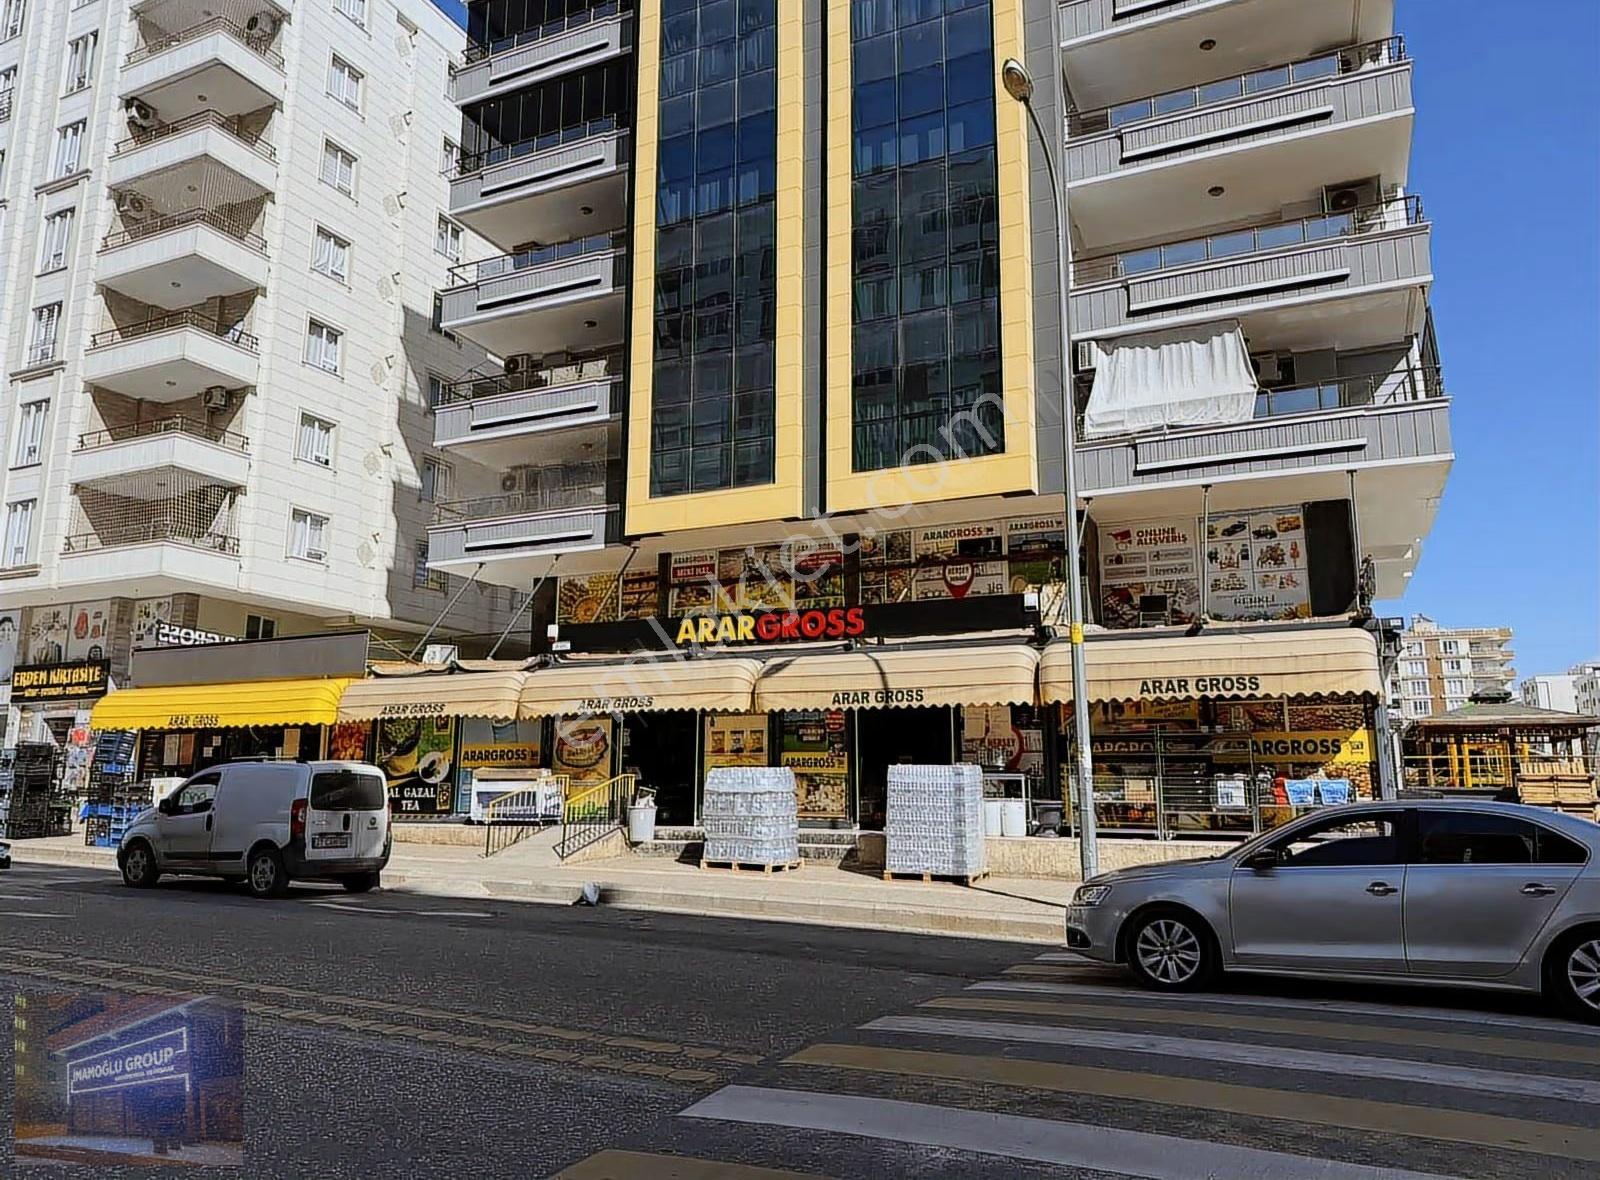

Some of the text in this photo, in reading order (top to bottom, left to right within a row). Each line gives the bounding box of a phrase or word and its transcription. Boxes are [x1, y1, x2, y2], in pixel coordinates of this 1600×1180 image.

[923, 526, 983, 541] ARARGROSS
[1136, 526, 1177, 538] ONLINE
[676, 607, 865, 644] ARARGROSS
[14, 670, 47, 687] ERDEM
[1139, 676, 1261, 695] ARAR GROSS
[578, 696, 655, 711] ARAR GROSS
[832, 689, 924, 705] ARAR GROSS
[380, 703, 446, 716] ARAR GROSS
[192, 713, 220, 727] GROSS
[463, 748, 528, 762] ARARGROSS
[784, 756, 836, 769] ARARGROSS
[404, 787, 437, 798] GAZAL
[401, 800, 420, 811] TEA
